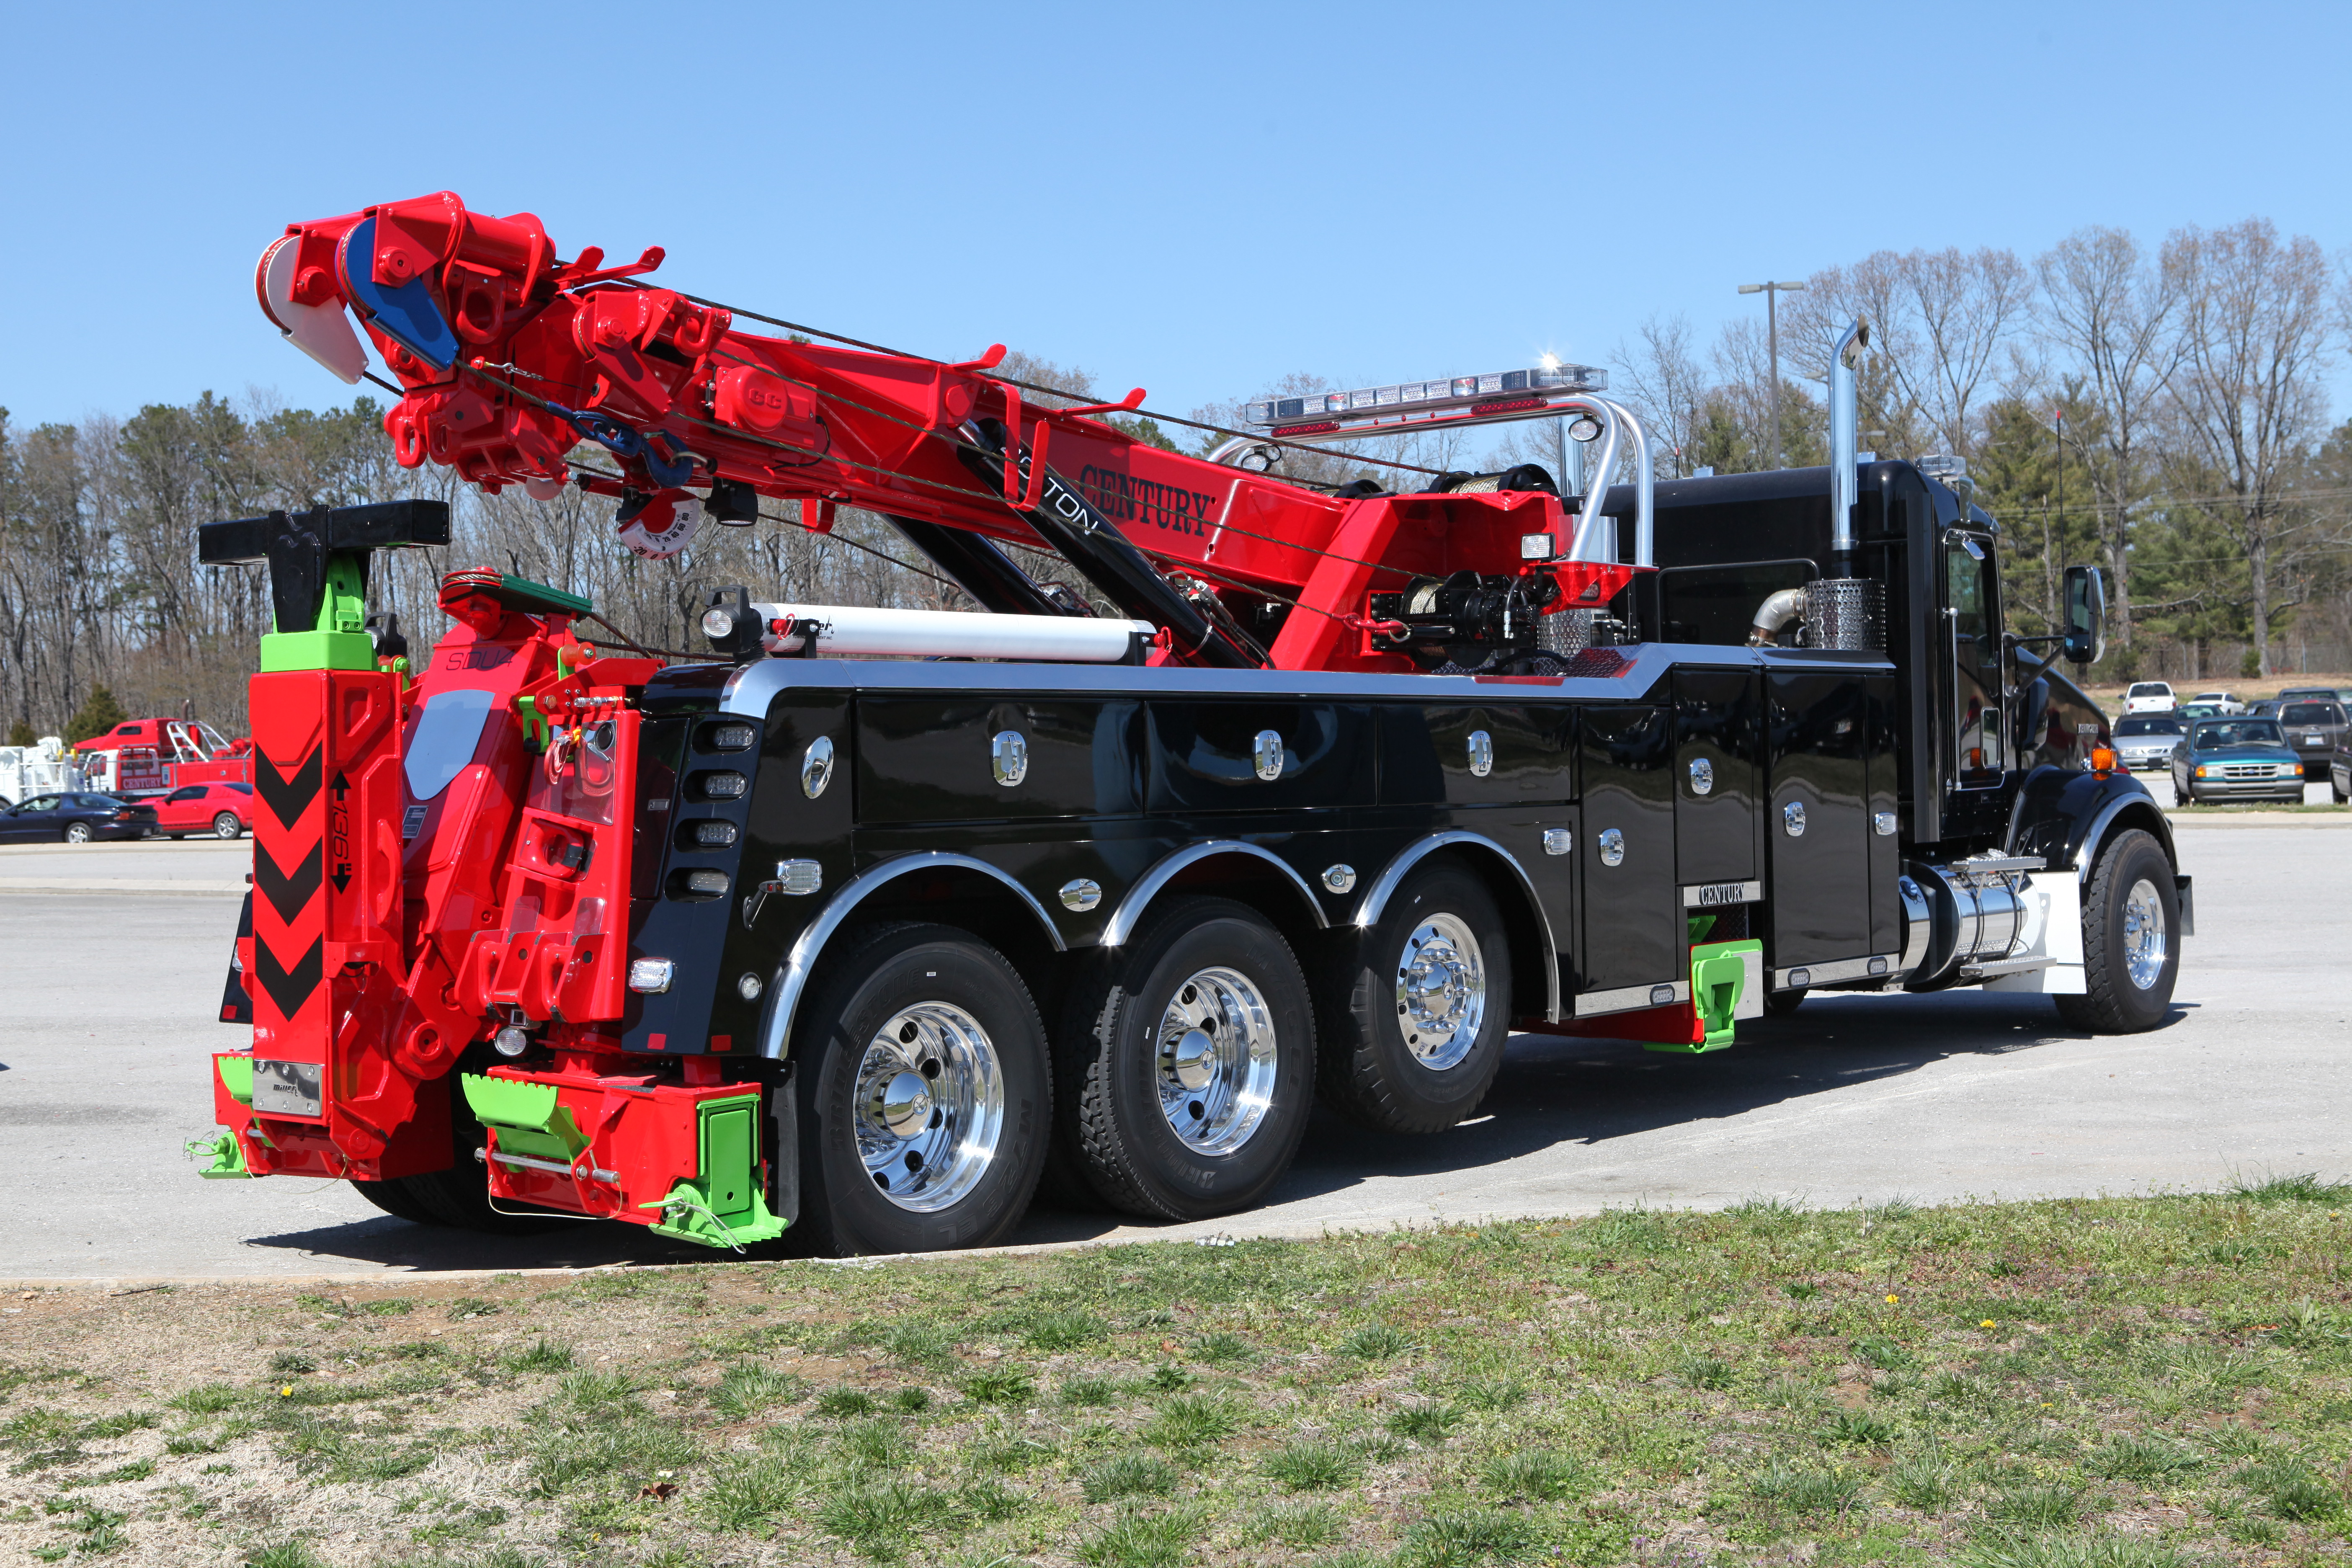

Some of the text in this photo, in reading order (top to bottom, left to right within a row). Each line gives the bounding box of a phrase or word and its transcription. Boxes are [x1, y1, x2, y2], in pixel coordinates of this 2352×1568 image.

[1044, 477, 1098, 535] TON
[1079, 464, 1210, 537] CENTURY
[677, 523, 686, 531] 60
[681, 513, 689, 521] 80
[634, 546, 647, 555] -20
[446, 650, 515, 671] SDU4
[123, 777, 162, 789] CENTURY
[1700, 881, 1745, 905] CENTURY
[829, 967, 919, 1151] BRIDGESTONE
[1138, 1040, 1217, 1189] BRIDGESTONE
[939, 1098, 1034, 1244] M726 EL
